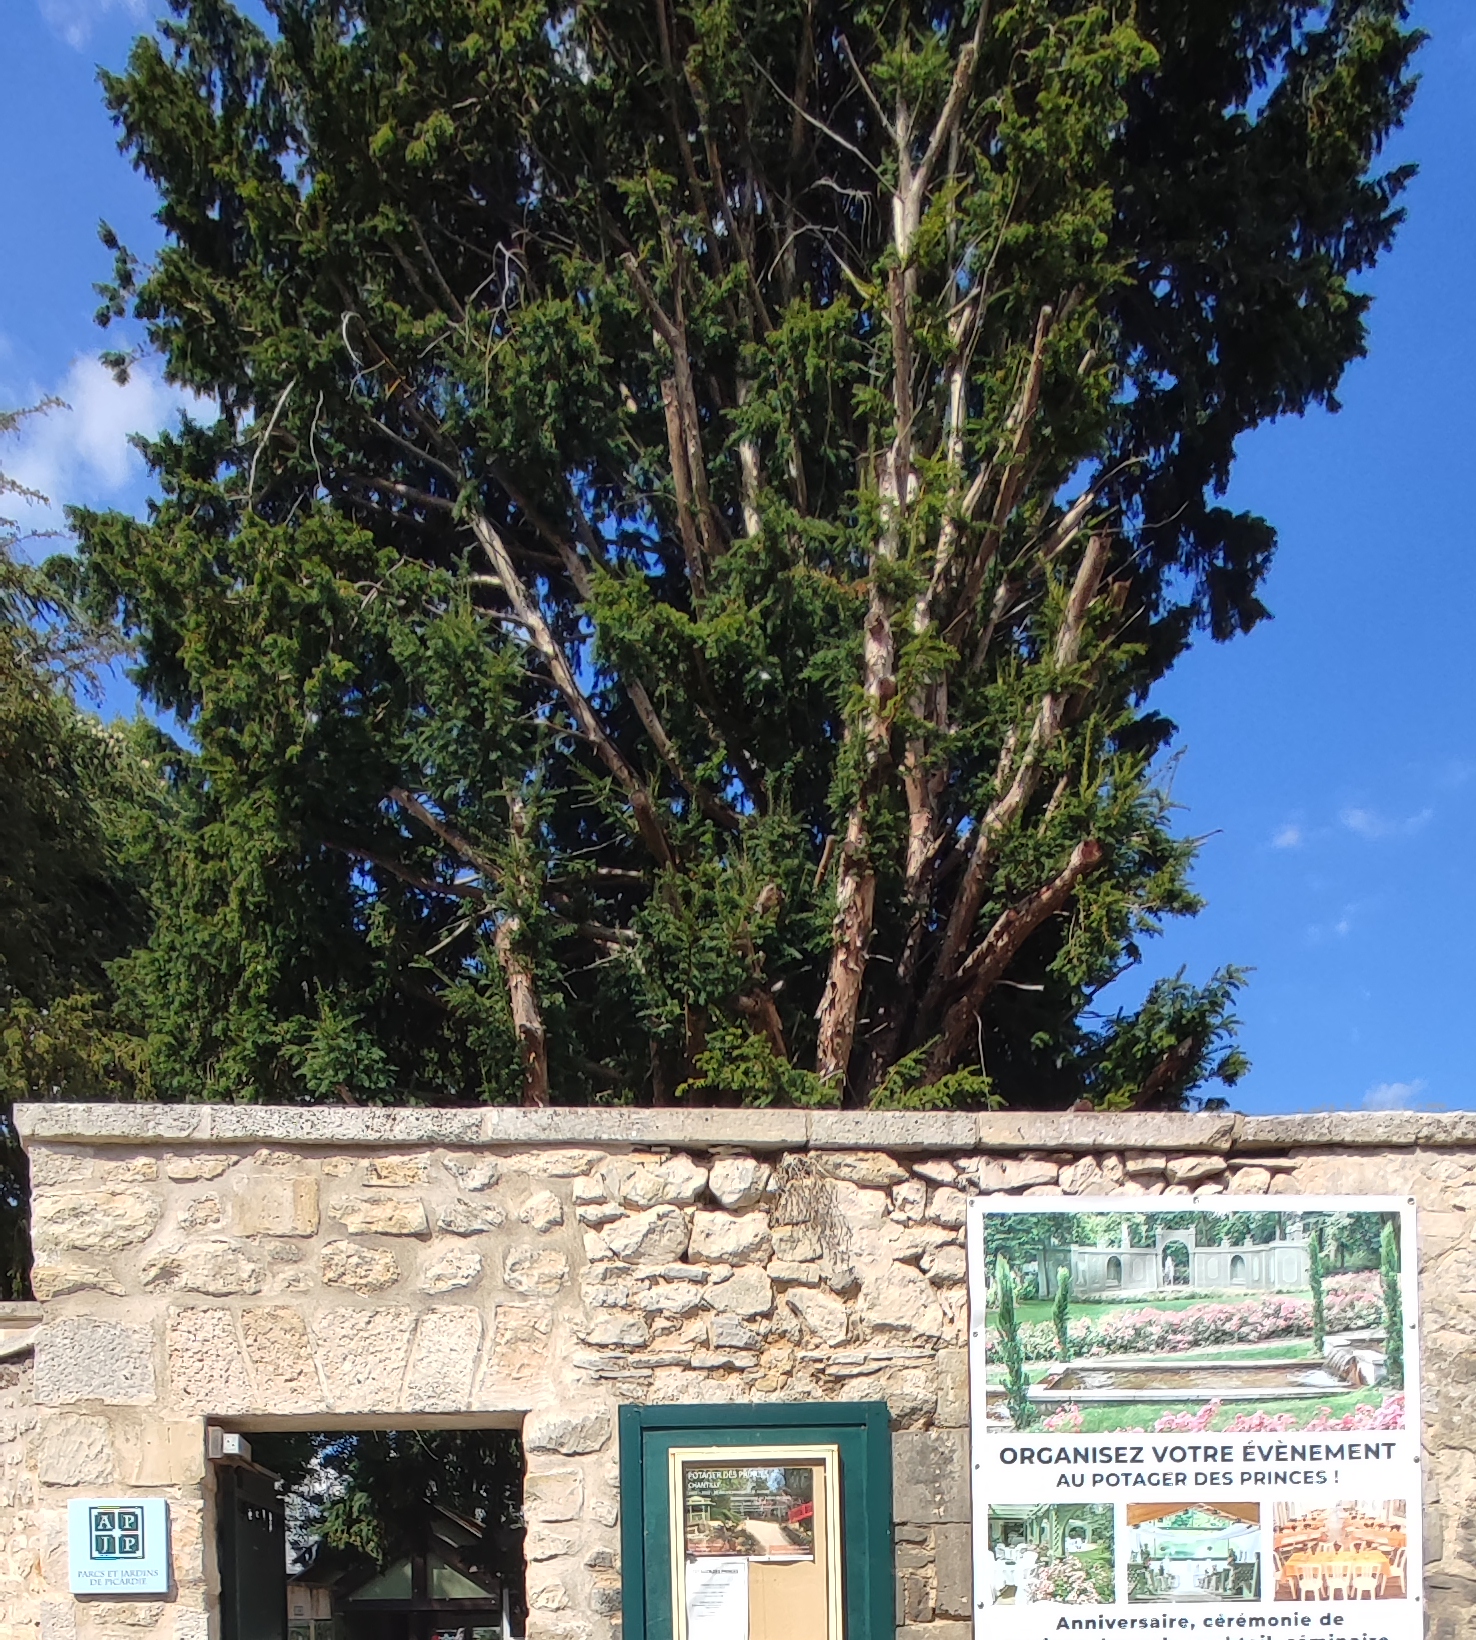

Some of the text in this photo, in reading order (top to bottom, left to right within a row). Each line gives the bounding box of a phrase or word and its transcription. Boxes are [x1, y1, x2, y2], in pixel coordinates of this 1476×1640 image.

[1000, 1440, 1397, 1465] ORGANISEZ VOTRE ÉVÈNEMENT
[1056, 1470, 1339, 1487] AU POTAGER DES PRINCES !
[78, 1570, 105, 1578] PARCS
[120, 1569, 159, 1578] JARDINS
[90, 1577, 147, 1586] DE PICARDIE
[1056, 1612, 1345, 1631] Anniversaire, cérémonie de
